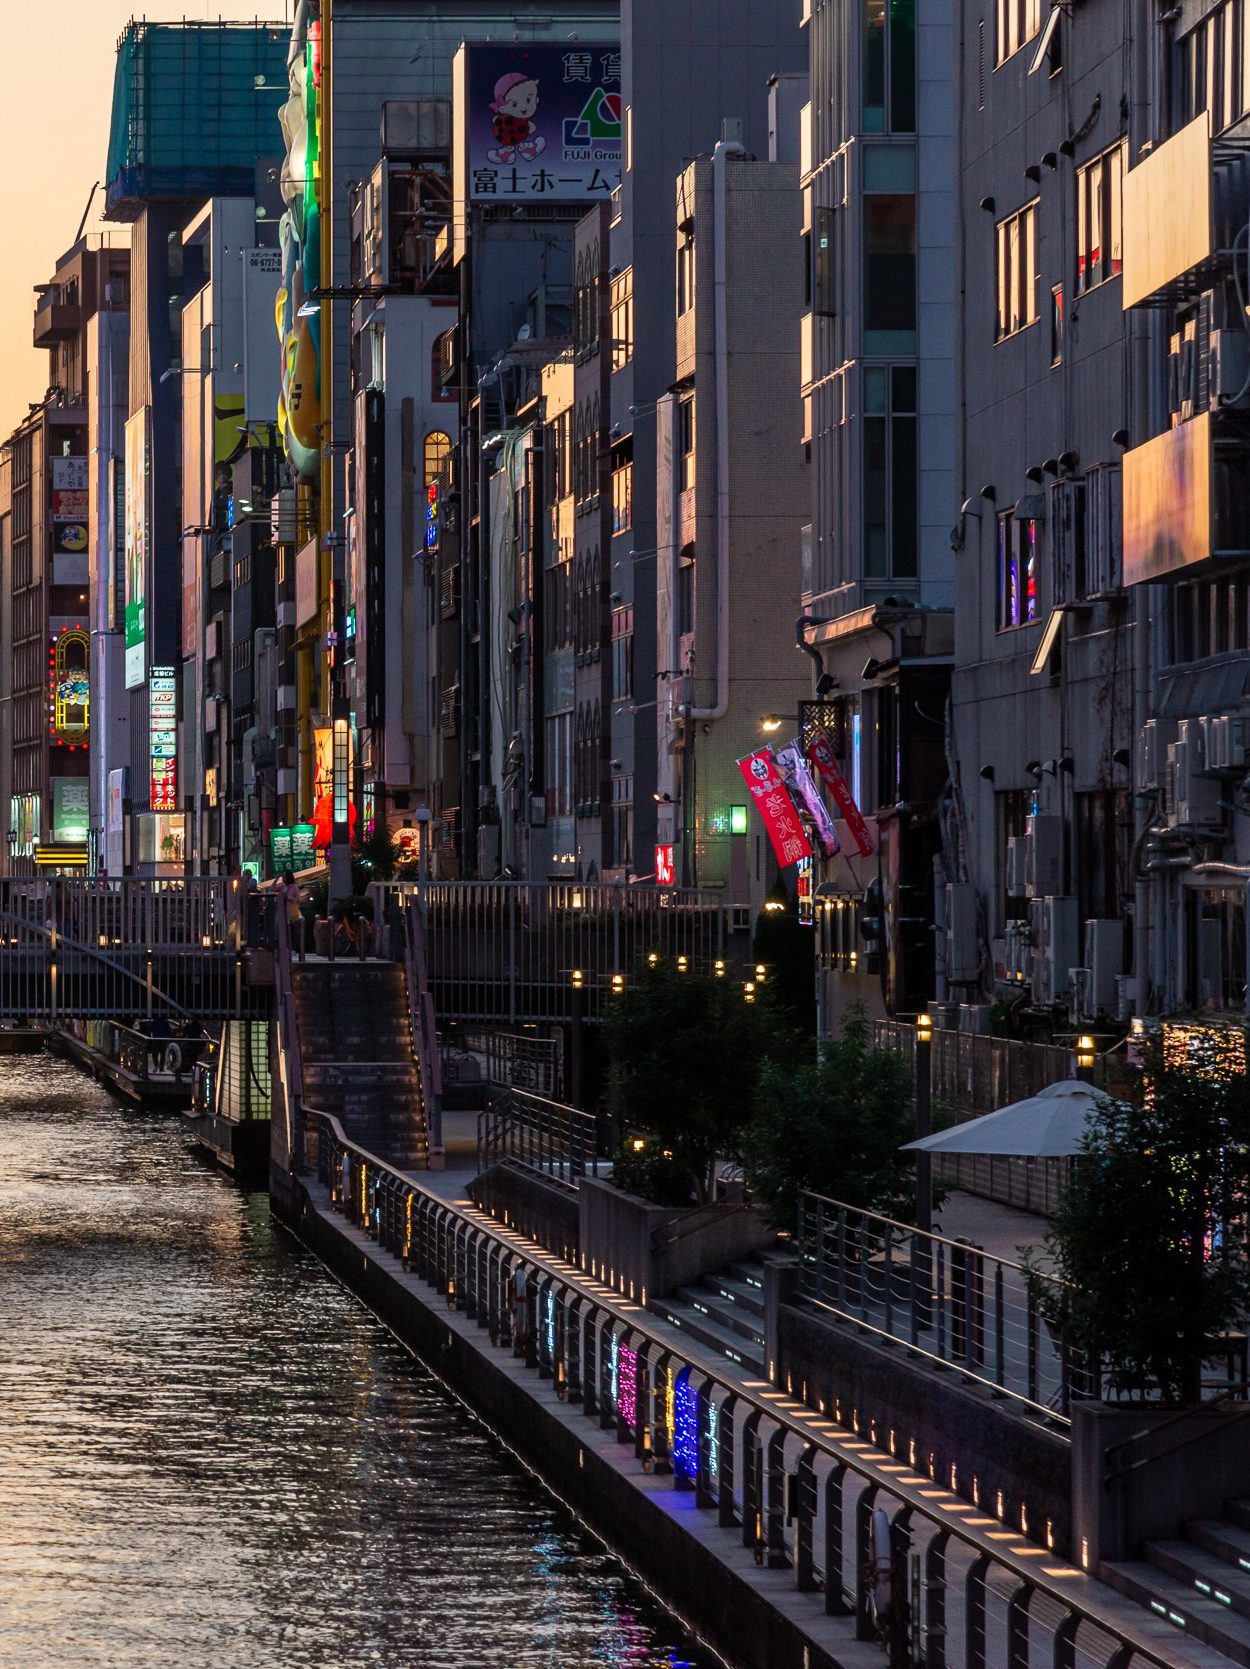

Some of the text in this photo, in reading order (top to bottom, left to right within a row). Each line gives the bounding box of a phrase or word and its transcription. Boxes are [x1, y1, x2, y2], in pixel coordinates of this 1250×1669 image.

[564, 150, 591, 160] FUJI
[472, 167, 621, 194] 富士ホーム
[154, 778, 164, 804] コミック
[165, 758, 175, 804] インターネット
[62, 785, 89, 811] 薬
[274, 836, 291, 856] 薬
[292, 833, 313, 853] 薬
